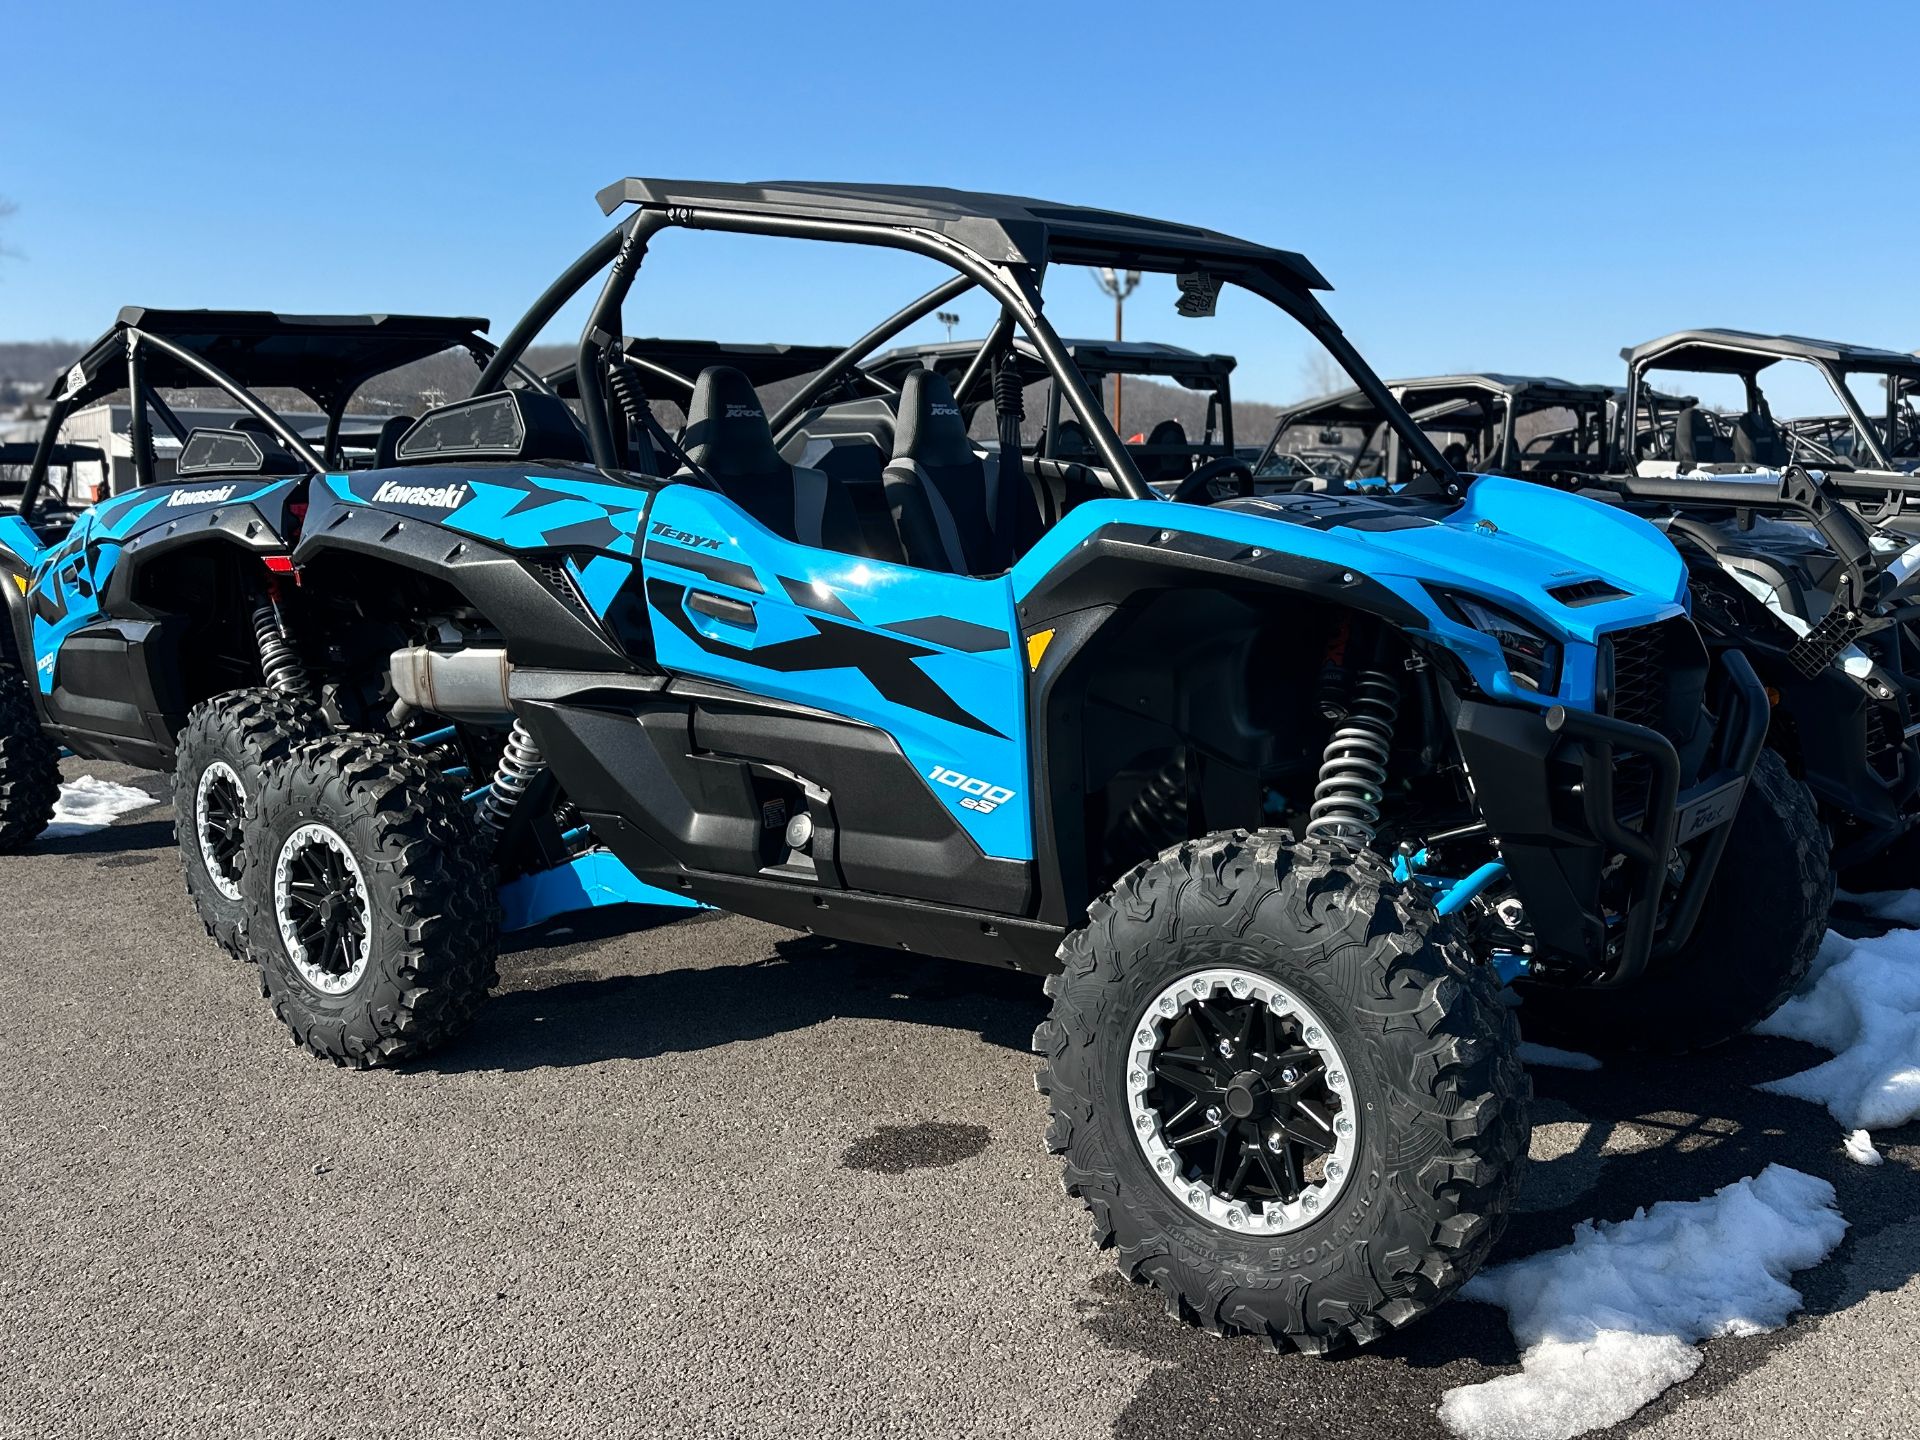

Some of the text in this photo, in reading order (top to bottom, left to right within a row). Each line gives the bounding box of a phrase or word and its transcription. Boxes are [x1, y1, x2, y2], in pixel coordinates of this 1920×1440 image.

[166, 484, 237, 507] Kawasaki
[372, 480, 468, 509] Kawasaki
[927, 764, 1017, 805] 1000
[1268, 1169, 1380, 1272] CARNIVORE
